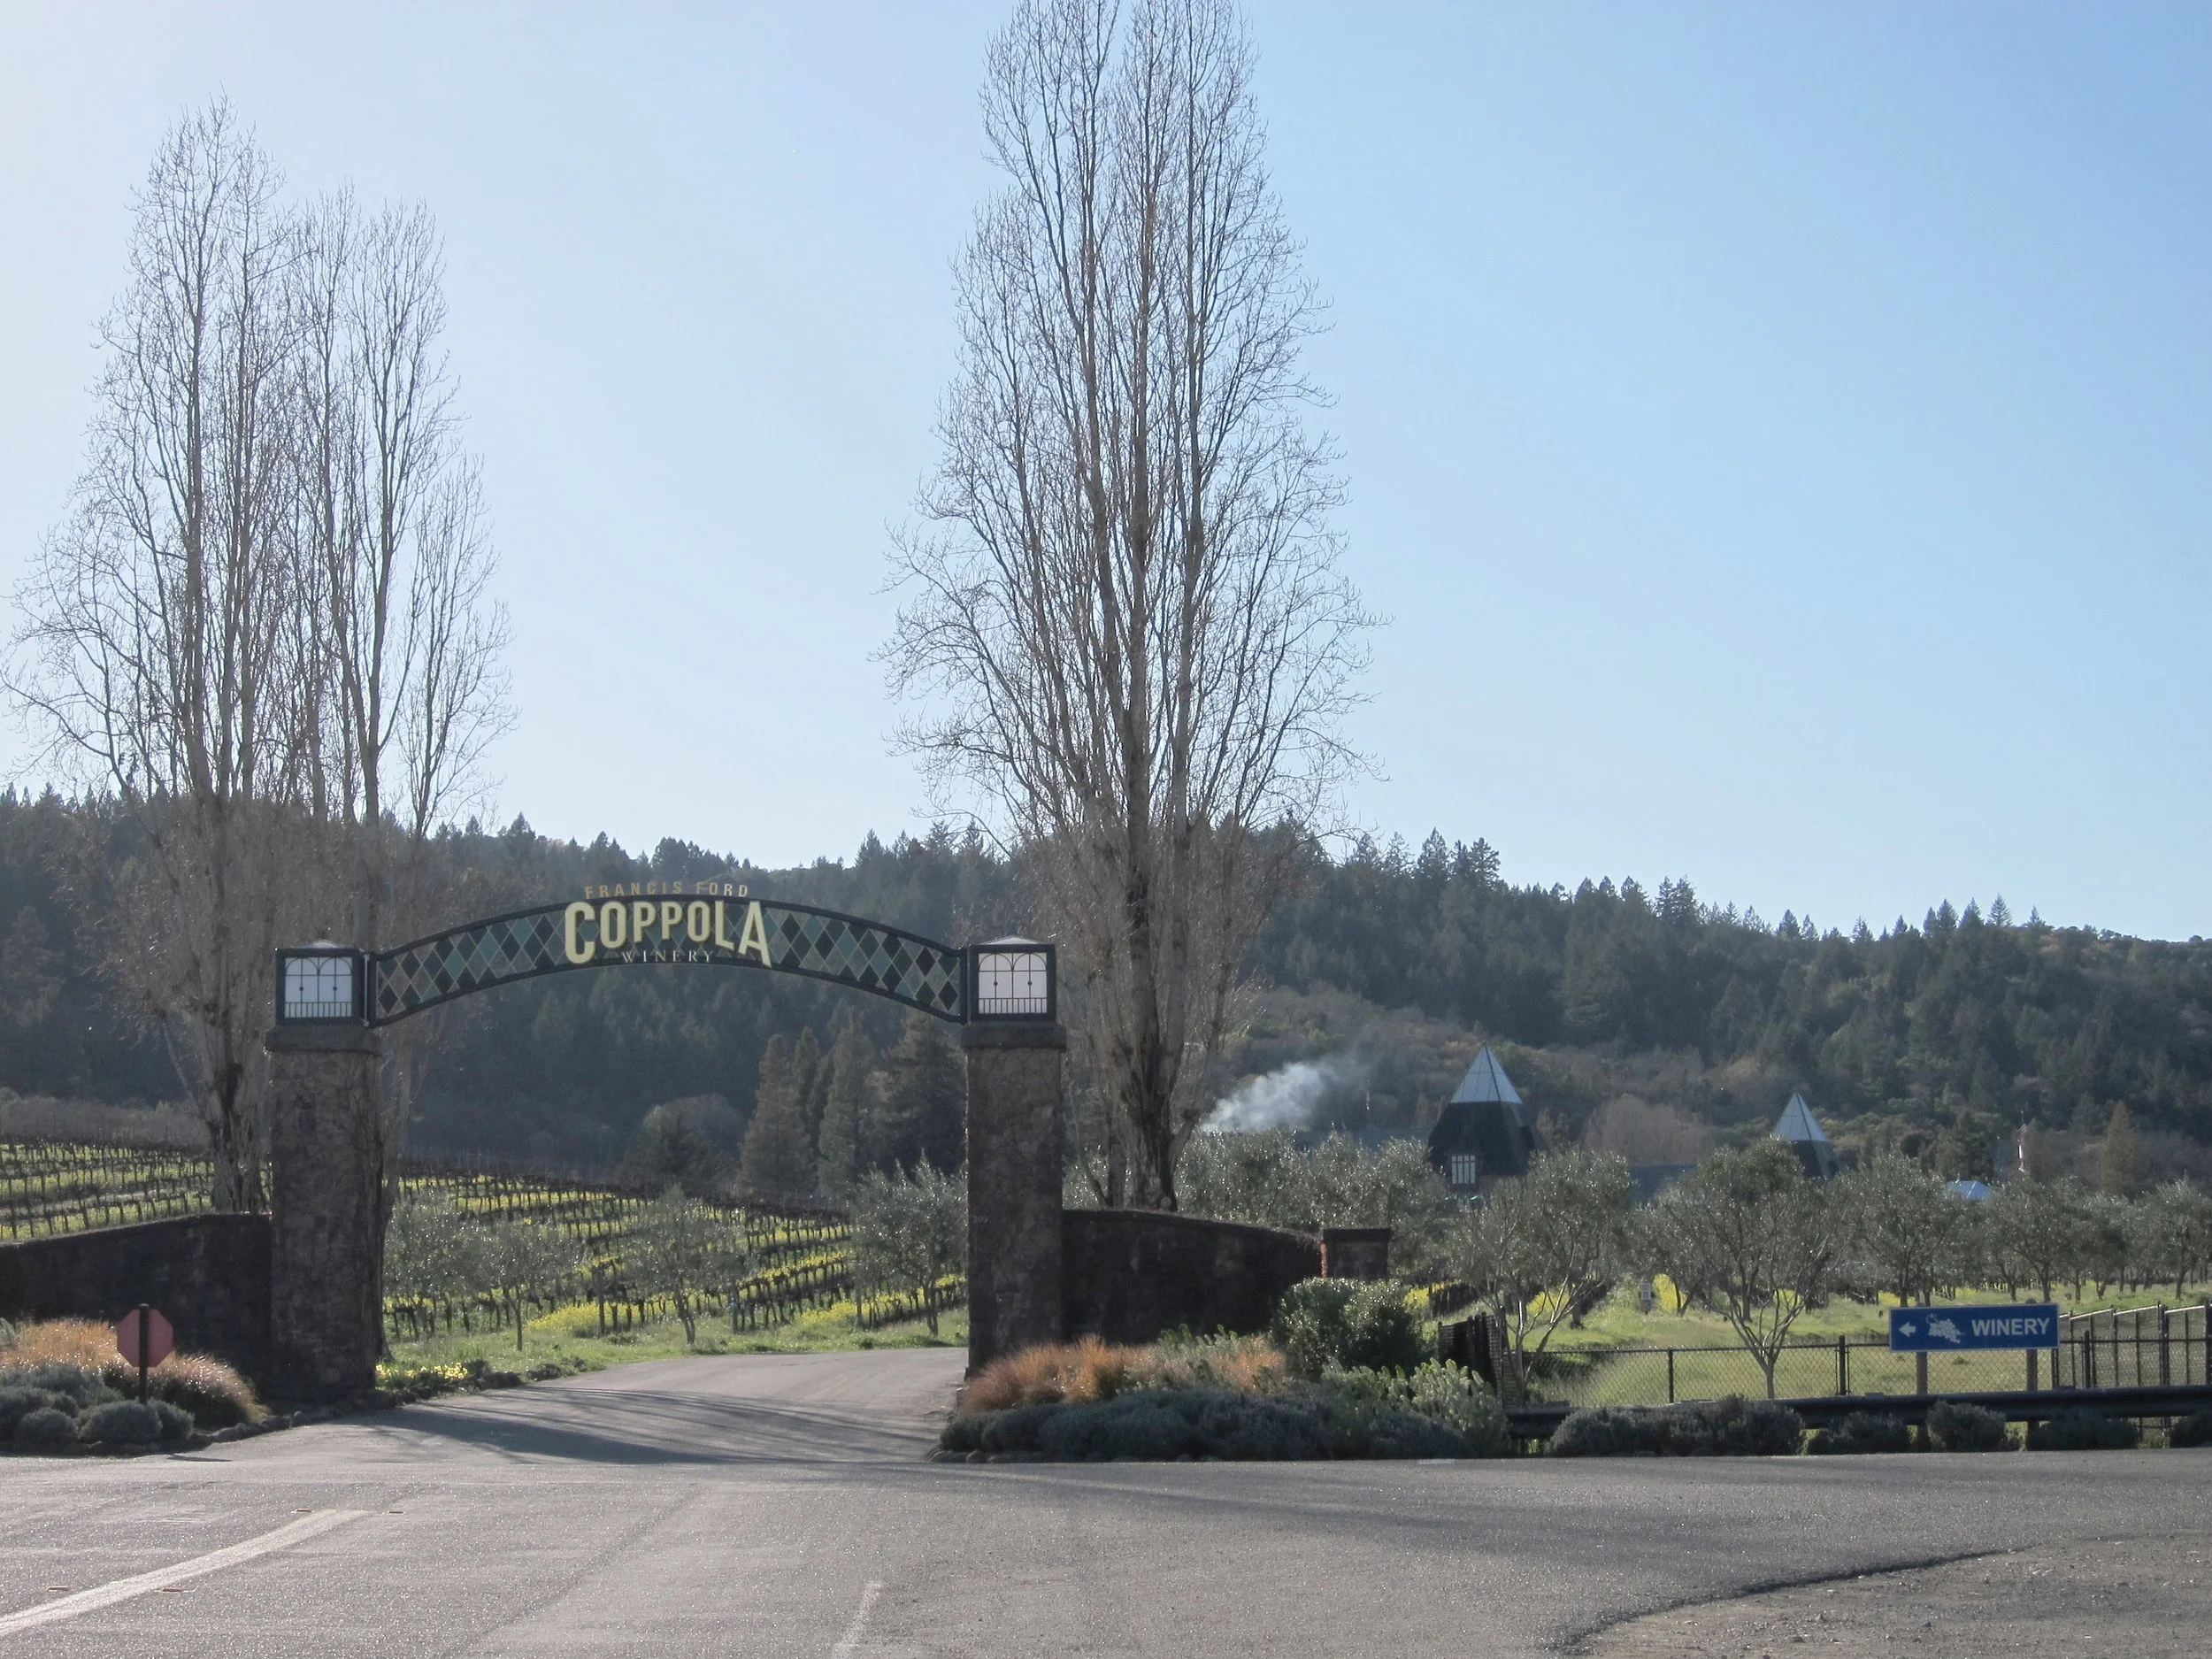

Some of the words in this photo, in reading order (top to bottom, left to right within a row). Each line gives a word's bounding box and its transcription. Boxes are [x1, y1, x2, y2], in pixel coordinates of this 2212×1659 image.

[584, 880, 682, 899] FRANCIS
[695, 881, 748, 898] FORD
[565, 900, 772, 969] COPPOLA
[622, 949, 713, 963] WINERY
[1971, 1317, 2050, 1336] WINERY
